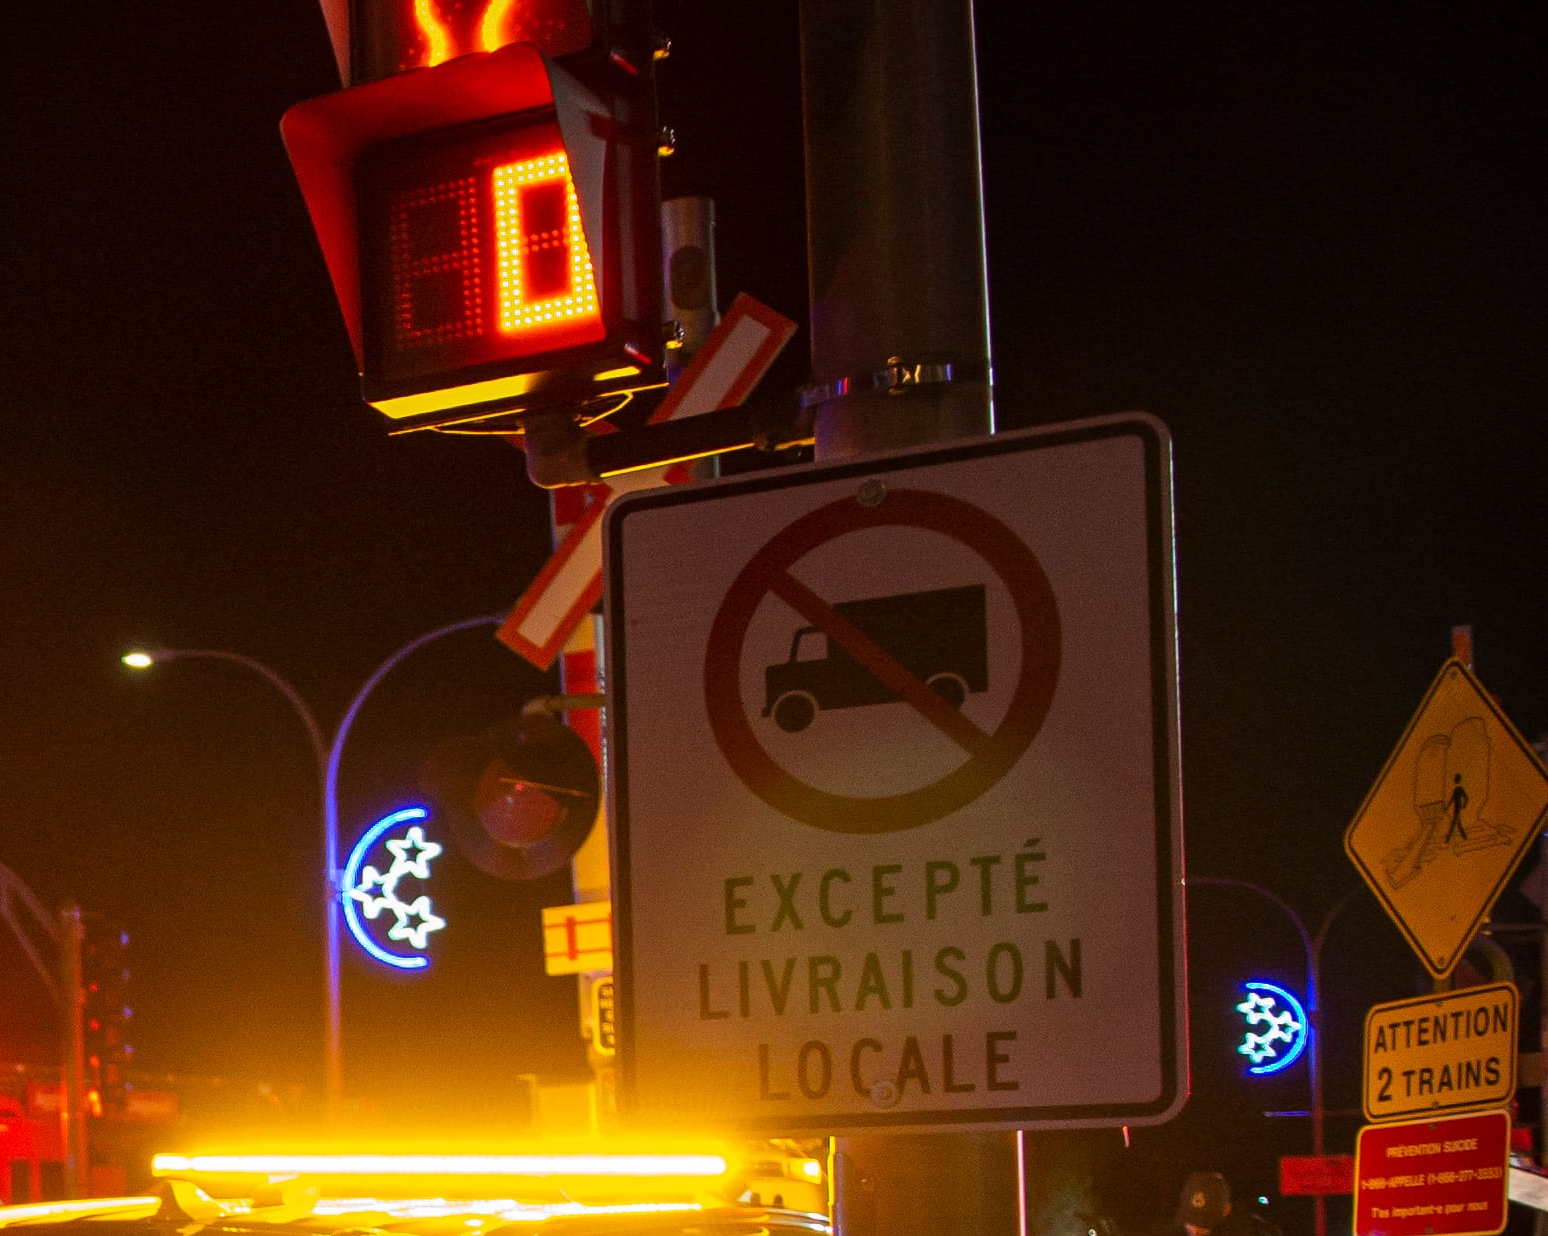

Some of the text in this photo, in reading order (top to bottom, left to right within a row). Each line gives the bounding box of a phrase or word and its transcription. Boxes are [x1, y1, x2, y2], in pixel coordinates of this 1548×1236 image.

[723, 837, 1048, 936] EXCEPTÉ
[699, 937, 1083, 1021] LIVRAISON
[1374, 1003, 1508, 1053] ATTENTION
[758, 1030, 1020, 1101] LOCALE
[1378, 1057, 1501, 1102] 2 TRAINS
